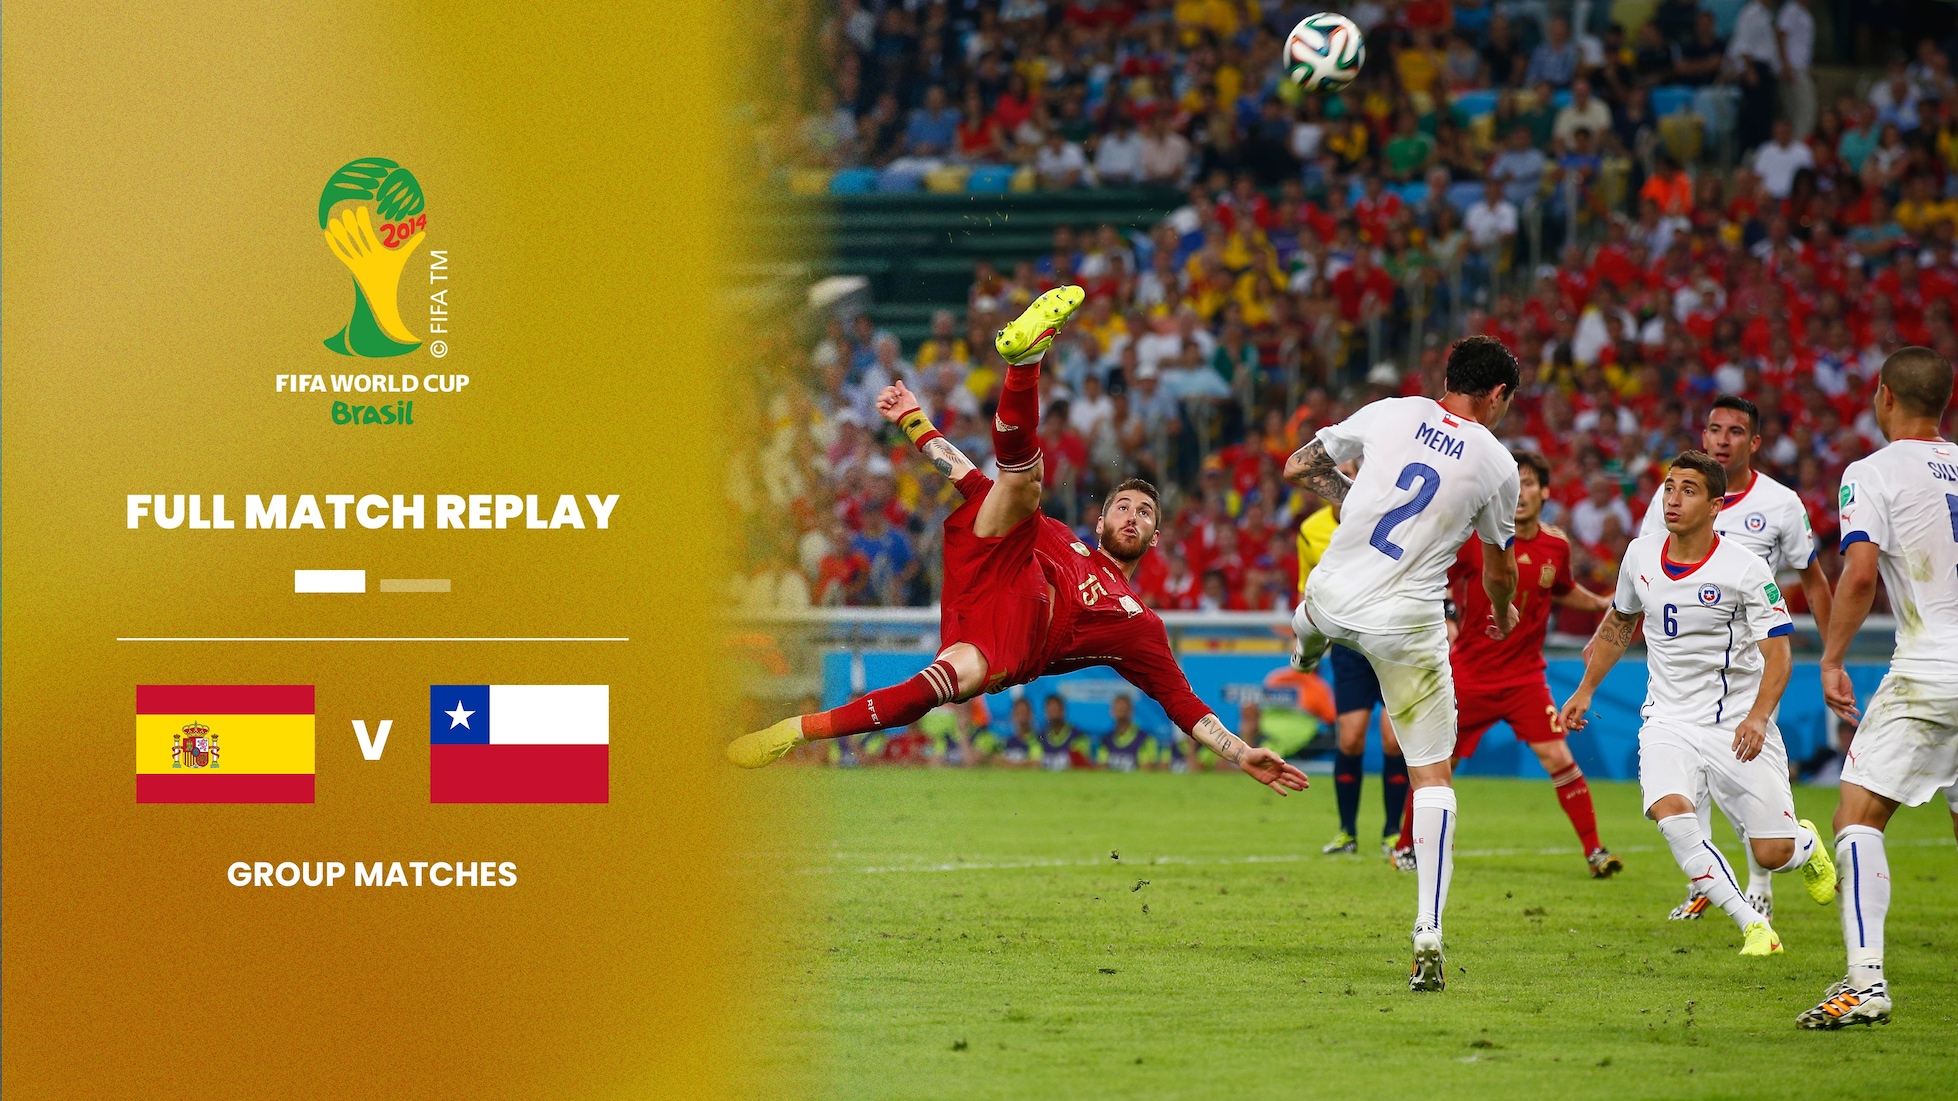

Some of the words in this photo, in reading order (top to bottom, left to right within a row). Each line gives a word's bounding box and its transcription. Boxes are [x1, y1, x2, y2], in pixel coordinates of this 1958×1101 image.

[1414, 421, 1466, 460] MENA
[1927, 461, 1958, 482] SIL
[1369, 461, 1441, 562] 2
[1078, 573, 1108, 606] 15
[1663, 602, 1679, 638] 6
[1545, 704, 1562, 733] 2
